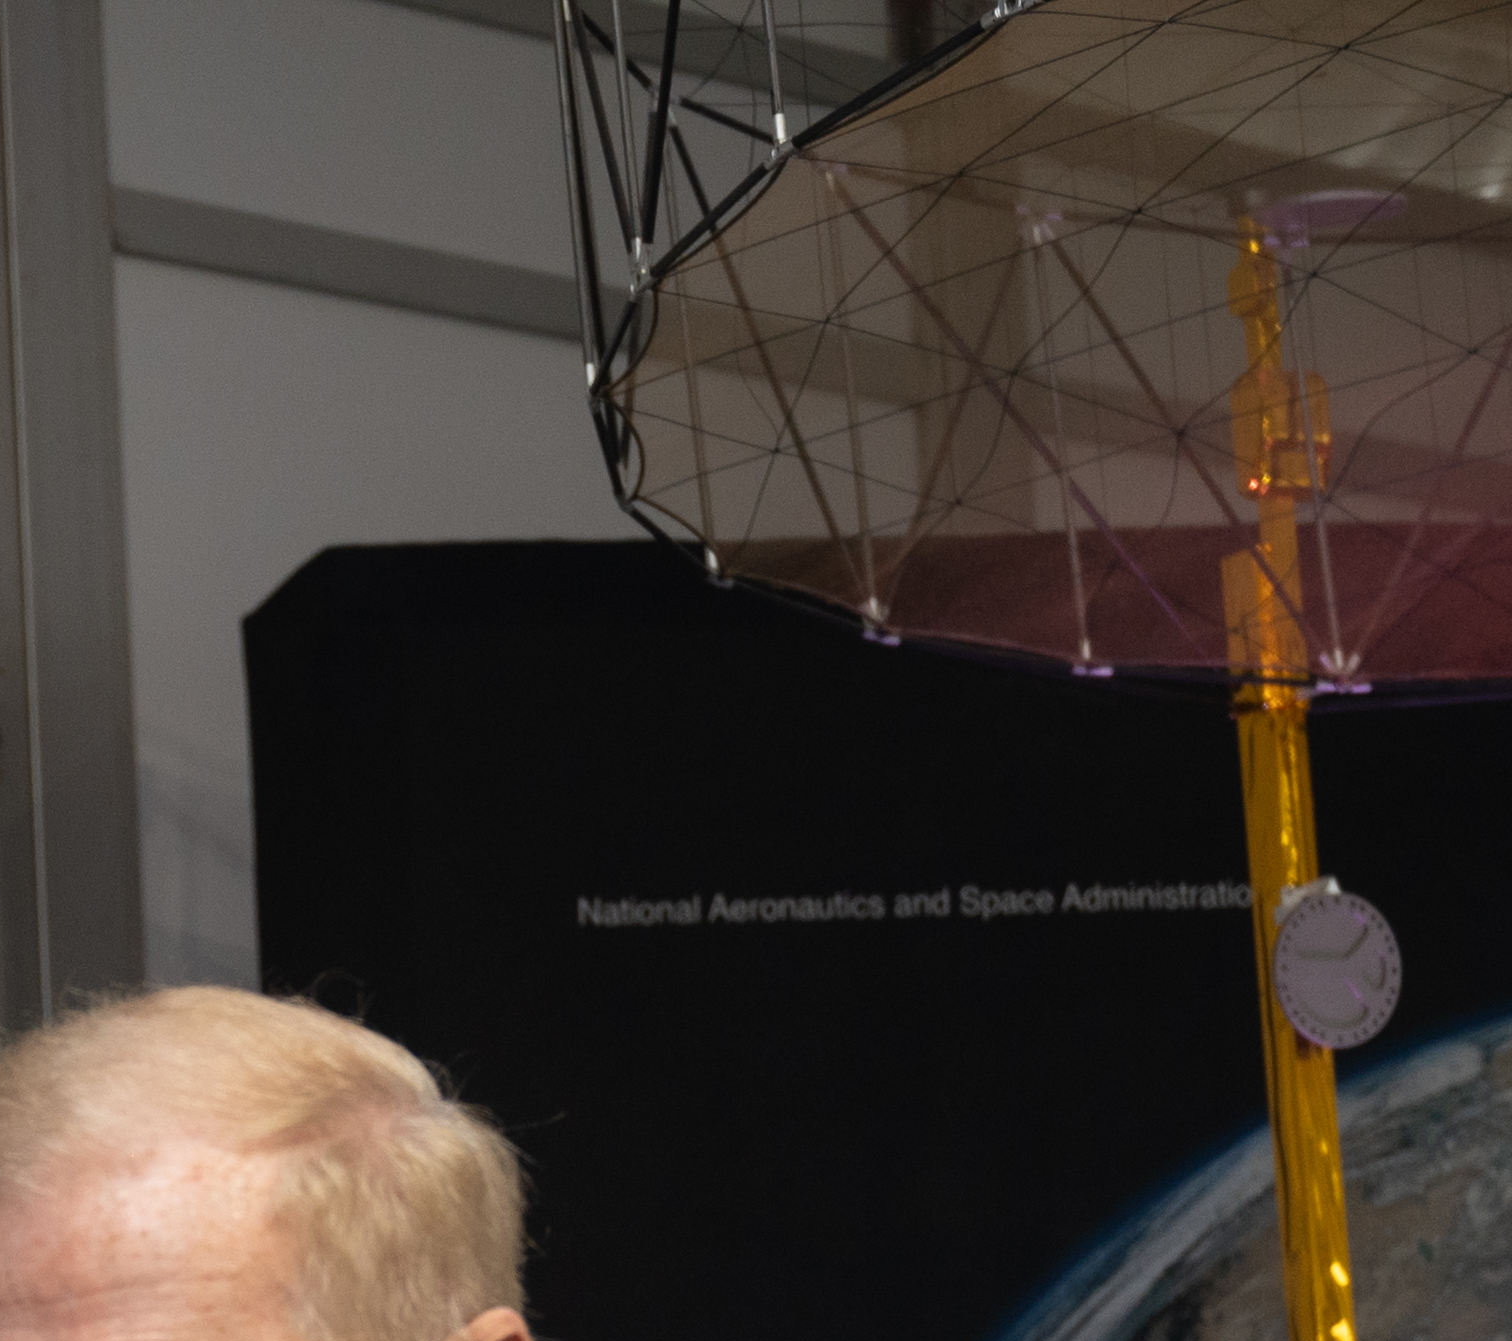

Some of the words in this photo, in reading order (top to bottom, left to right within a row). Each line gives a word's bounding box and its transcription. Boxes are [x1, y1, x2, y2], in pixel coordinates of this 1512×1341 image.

[577, 893, 703, 927] National
[707, 890, 887, 923] Aeronautics
[893, 886, 952, 919] and
[958, 883, 1056, 922] Space
[1060, 879, 1254, 914] Administratio
